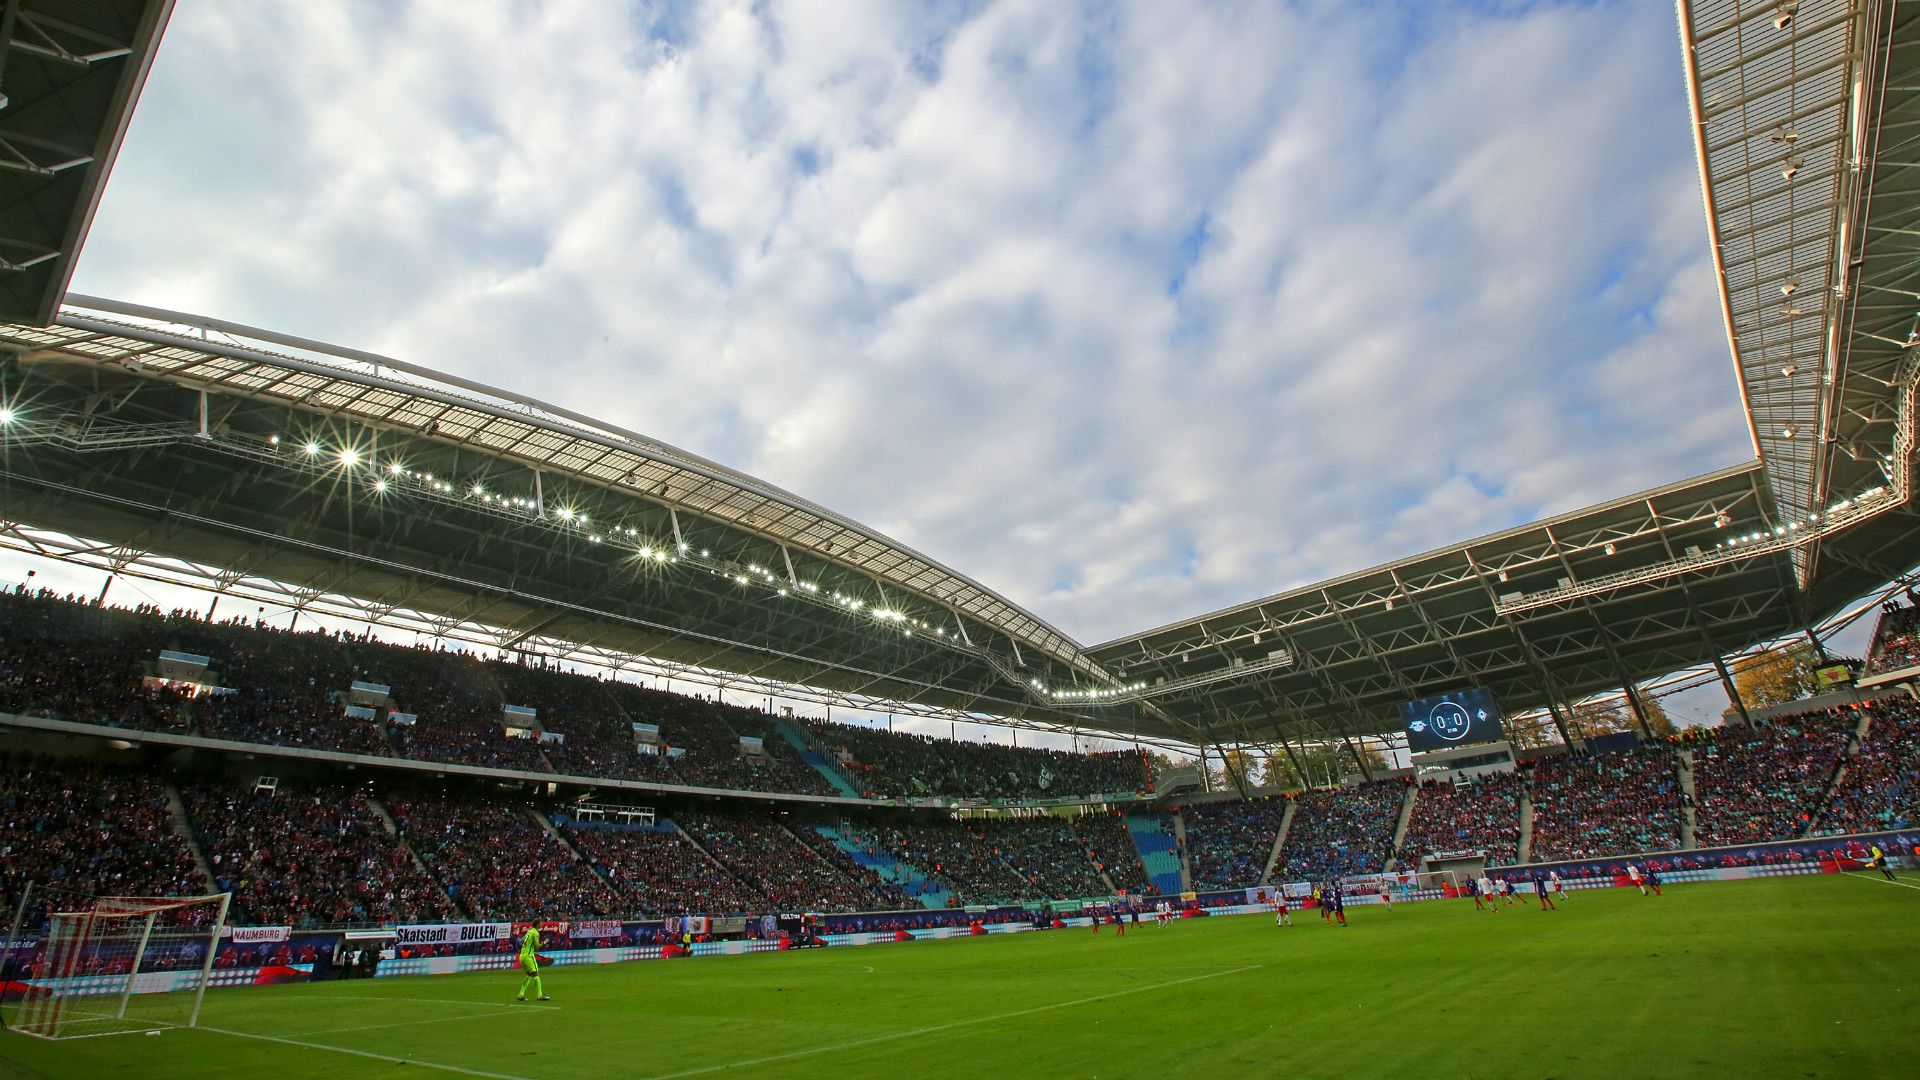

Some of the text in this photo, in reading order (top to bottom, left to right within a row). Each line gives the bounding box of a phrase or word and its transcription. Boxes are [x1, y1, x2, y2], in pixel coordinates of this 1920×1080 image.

[234, 930, 280, 940] NAUMBURG
[397, 928, 447, 942] Skatstadt
[460, 925, 496, 940] BULLEN
